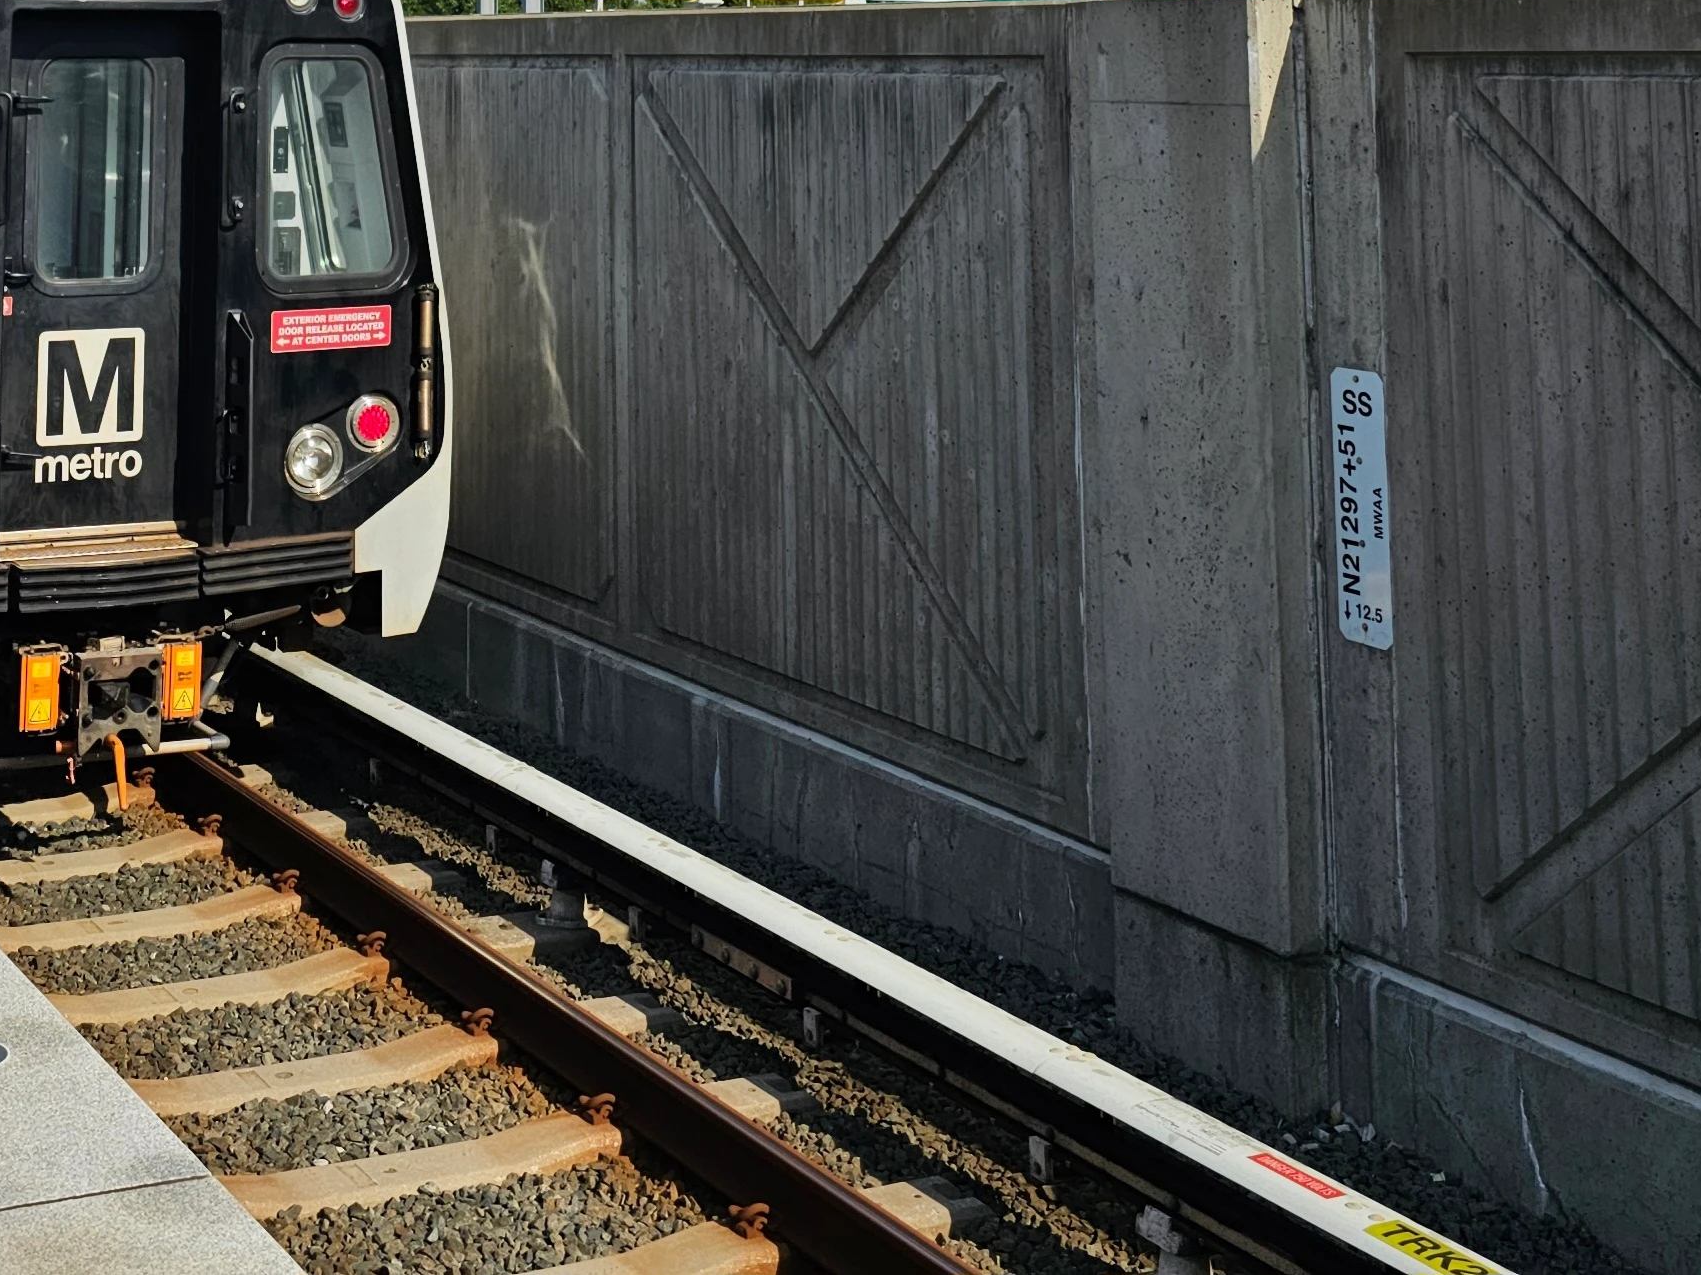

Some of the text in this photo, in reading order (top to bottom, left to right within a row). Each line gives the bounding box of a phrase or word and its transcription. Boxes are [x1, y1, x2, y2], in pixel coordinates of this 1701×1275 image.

[278, 322, 384, 336] DOOR RELEASE LOCATED
[282, 312, 381, 325] EXTERIOR EMERGENCY
[292, 333, 371, 345] AT CENTER DOORS
[46, 337, 135, 436] M
[1342, 389, 1372, 417] SS
[34, 447, 143, 483] metro
[1372, 487, 1383, 539] MWAA
[1355, 604, 1383, 623] 12.5
